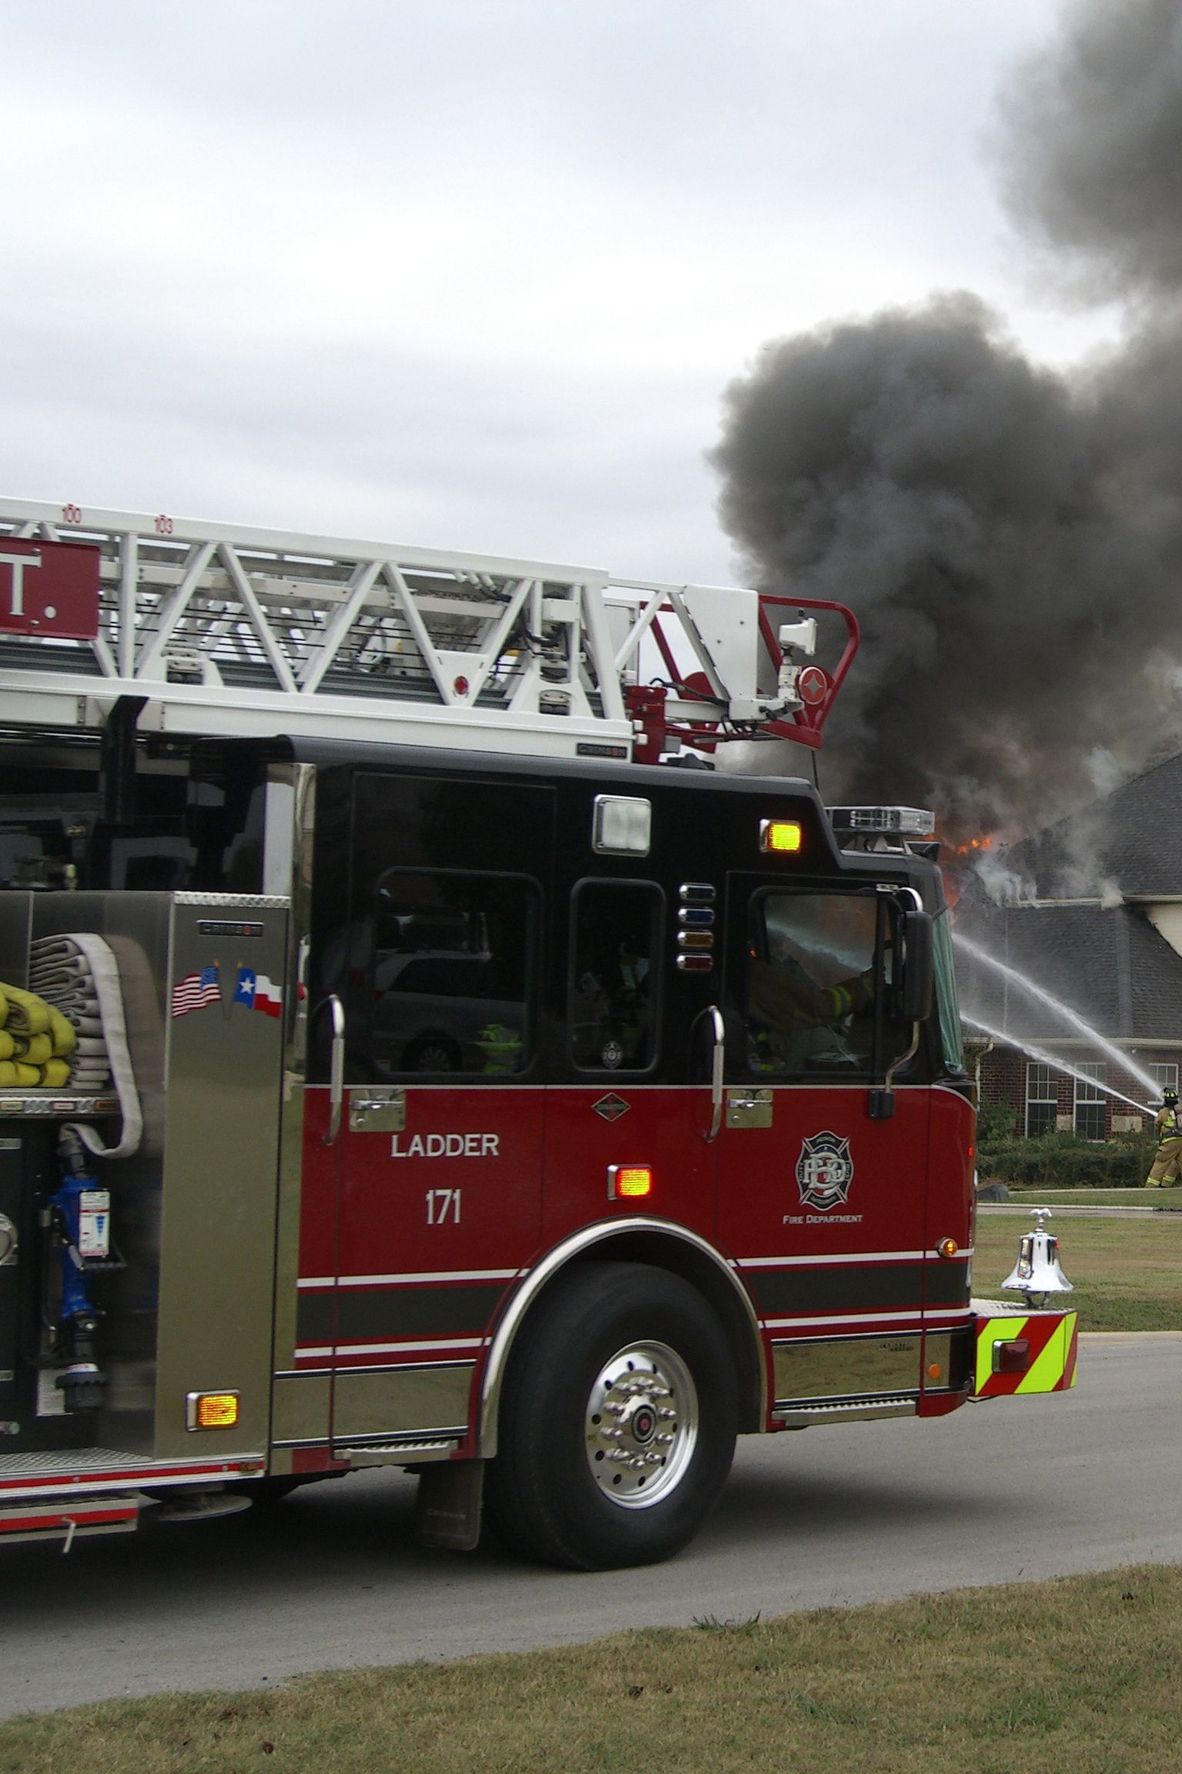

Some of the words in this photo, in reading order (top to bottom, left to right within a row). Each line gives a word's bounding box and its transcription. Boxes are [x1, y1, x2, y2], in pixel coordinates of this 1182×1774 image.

[62, 504, 82, 524] 100
[155, 514, 174, 534] 103
[391, 1134, 499, 1157] LADDER
[426, 1189, 460, 1224] 171
